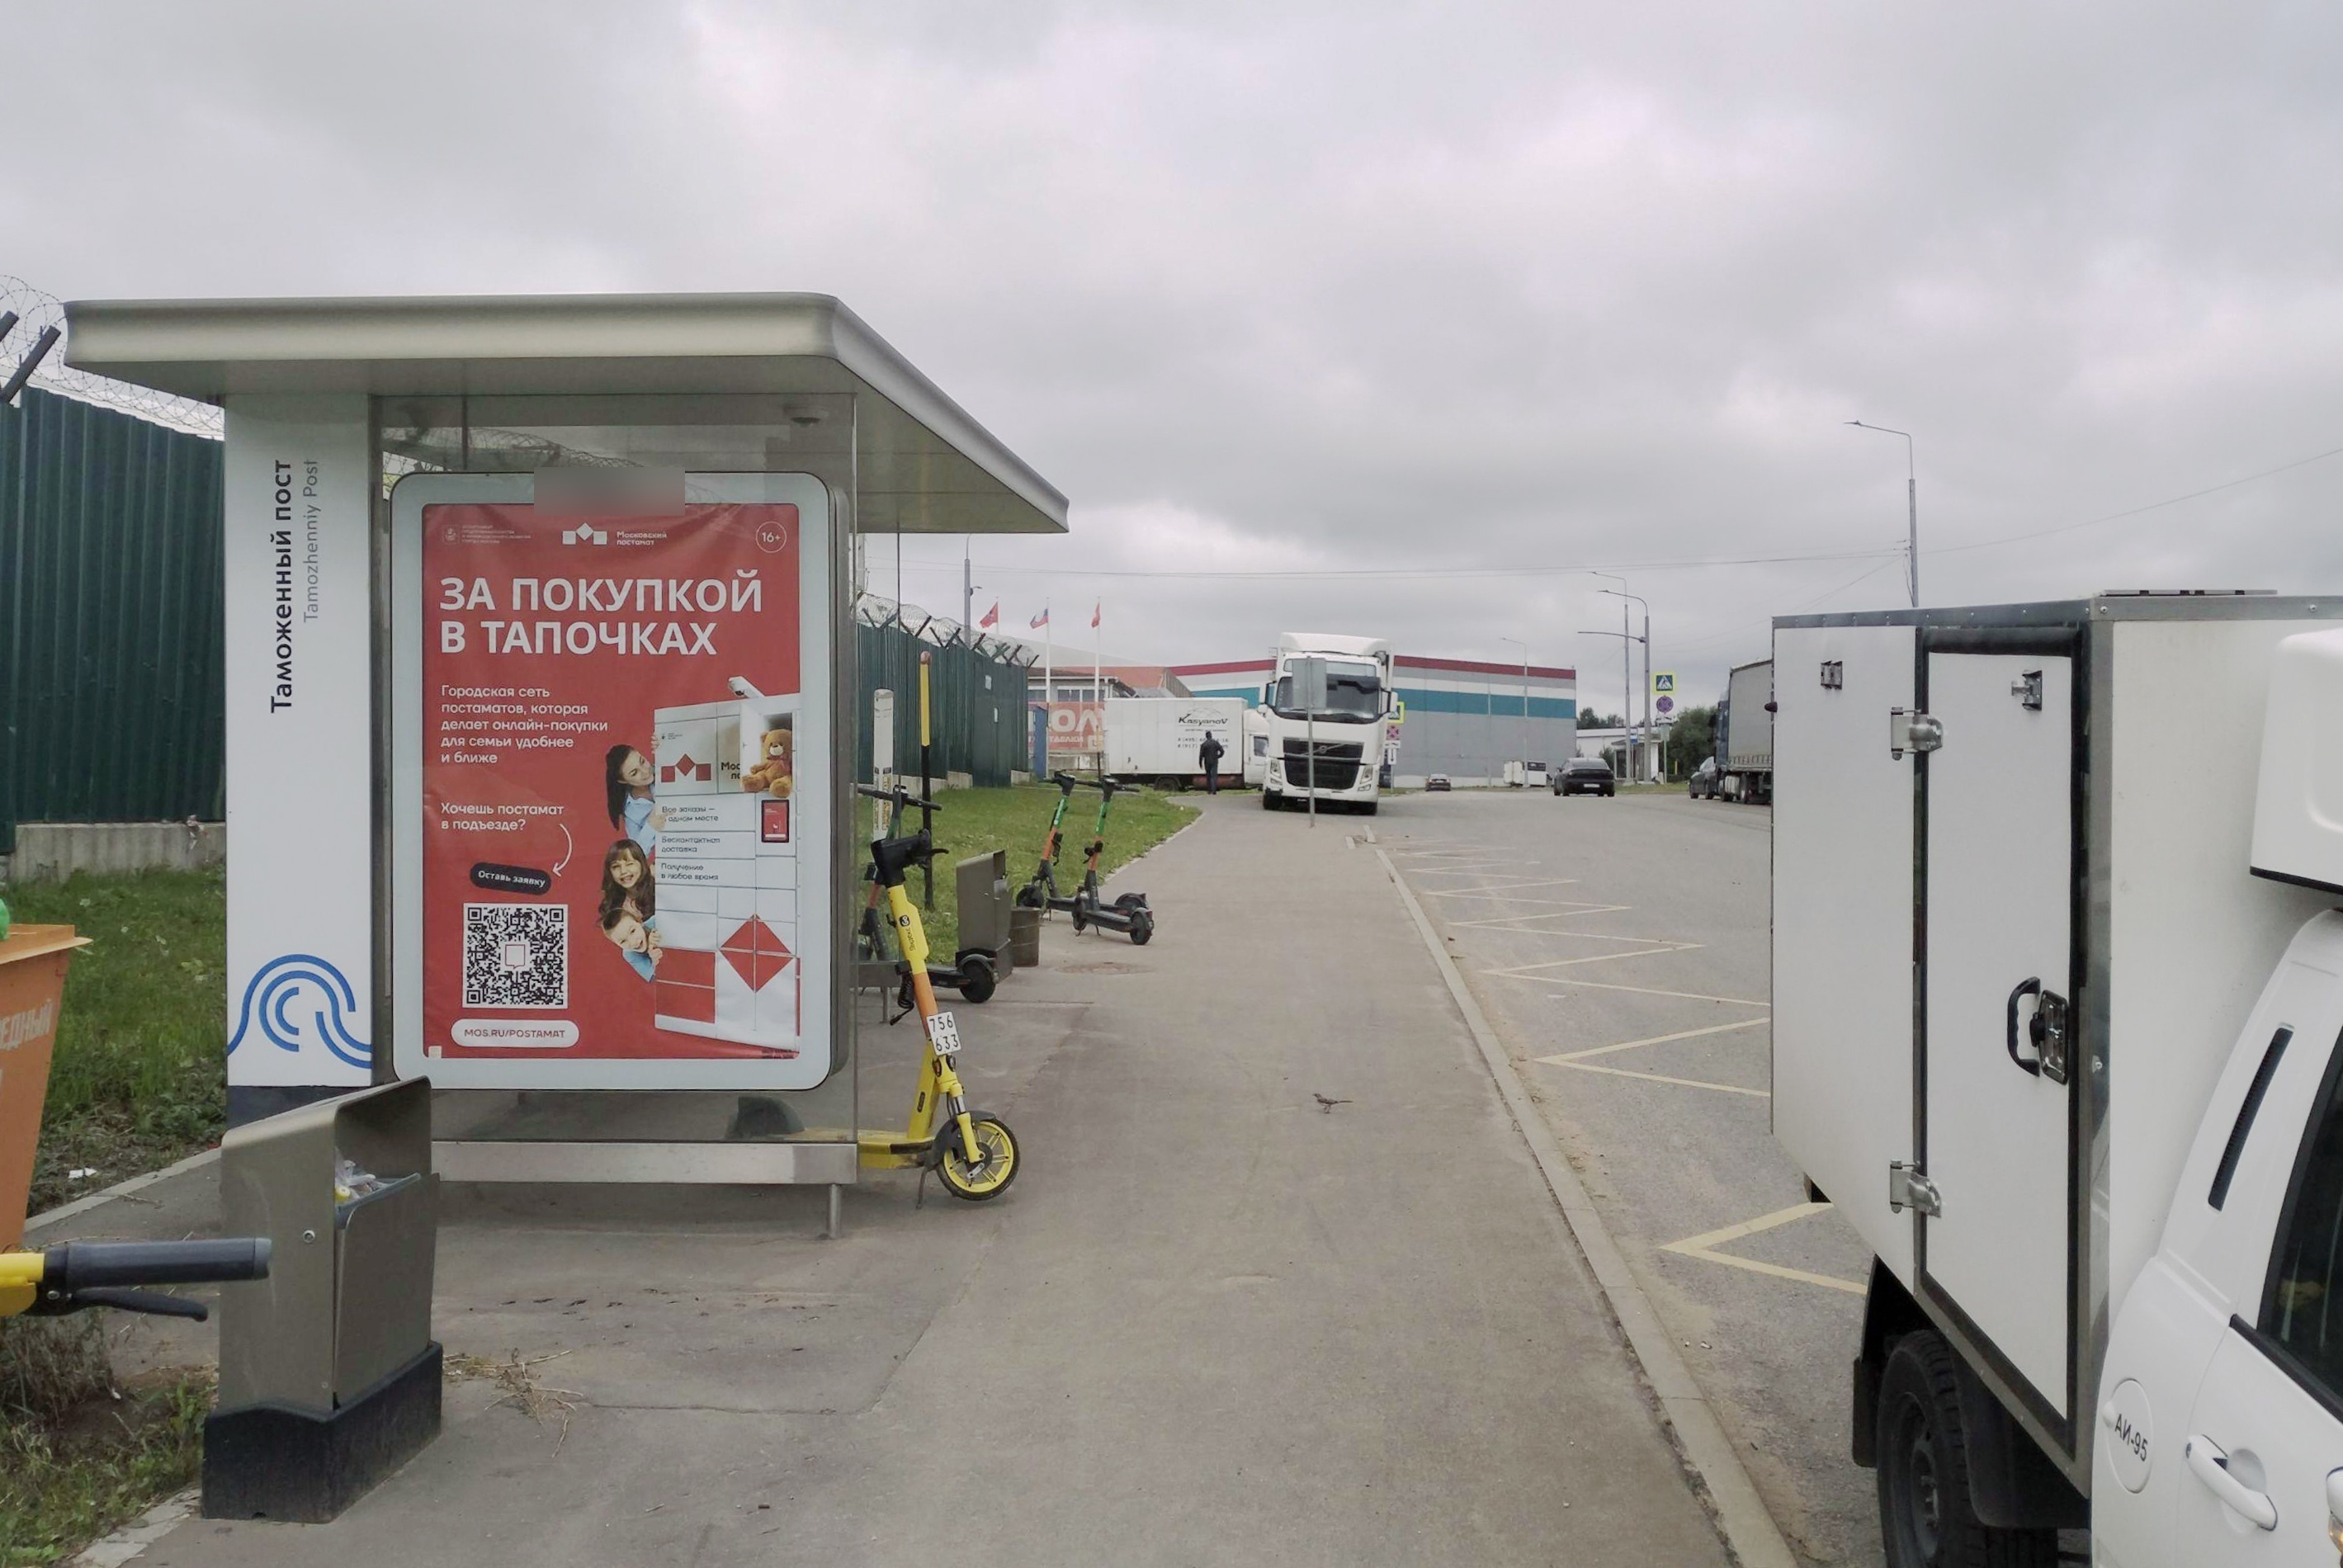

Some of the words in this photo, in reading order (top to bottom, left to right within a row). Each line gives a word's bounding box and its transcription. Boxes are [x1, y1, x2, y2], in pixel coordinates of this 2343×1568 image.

[303, 459, 318, 497] Post
[275, 460, 292, 521] пост
[616, 530, 668, 539] Московский
[762, 531, 781, 543] 16+
[303, 503, 321, 623] Tamozhenniy
[439, 577, 496, 611] ЗА
[512, 569, 762, 612] ПОКУПКОЙ
[270, 530, 292, 714] Таможенный
[440, 621, 465, 654] В
[480, 621, 717, 655] ТАПОЧКАХ
[441, 685, 515, 698] Городская
[518, 687, 550, 697] сеть
[441, 704, 527, 716] постаматов,
[531, 705, 588, 716] которая
[441, 720, 489, 731] делает
[493, 719, 608, 734] онлайн-покупки
[441, 736, 465, 748] для
[469, 737, 512, 747] семьи
[516, 736, 574, 750] удобнее
[441, 753, 450, 763] и
[454, 751, 498, 763] ближе
[441, 802, 494, 815] Хочешь
[498, 805, 564, 815] постамат
[441, 820, 449, 829] в
[453, 819, 527, 831] подъезде?
[478, 870, 512, 881] Оставь
[513, 876, 546, 888] заявку
[929, 1014, 954, 1032] 756
[464, 1028, 566, 1038] MOS.RU/POSTAMAT
[935, 1034, 959, 1052] 633
[2114, 1413, 2148, 1462] АИ-95
